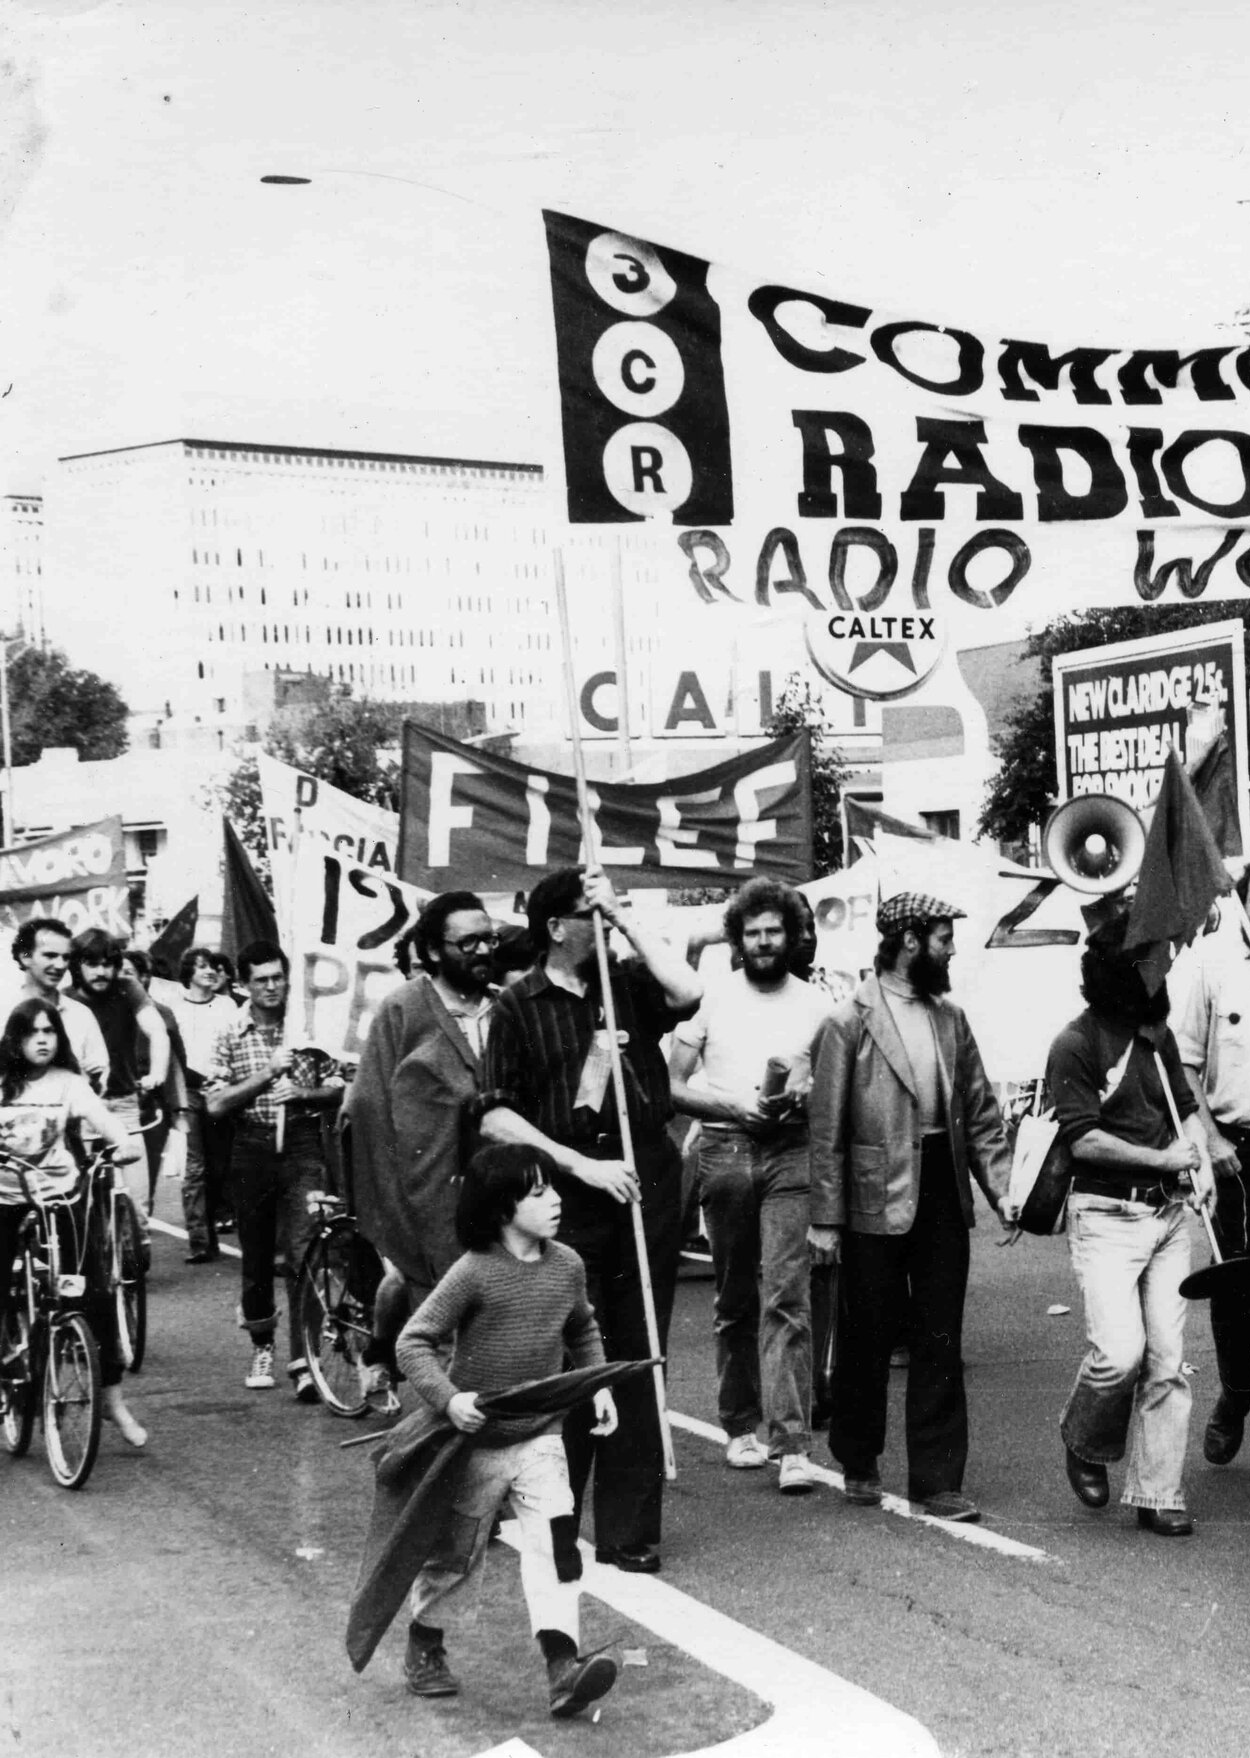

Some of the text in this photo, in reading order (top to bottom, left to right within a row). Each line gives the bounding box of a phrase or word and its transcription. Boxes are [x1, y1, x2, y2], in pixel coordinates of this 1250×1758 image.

[677, 526, 1032, 613] RADIO
[828, 615, 936, 640] CALTEX
[1068, 679, 1107, 723] NEW
[1107, 665, 1193, 719] CLARIDGE
[1067, 731, 1099, 774] THE
[428, 751, 798, 869] FILEF
